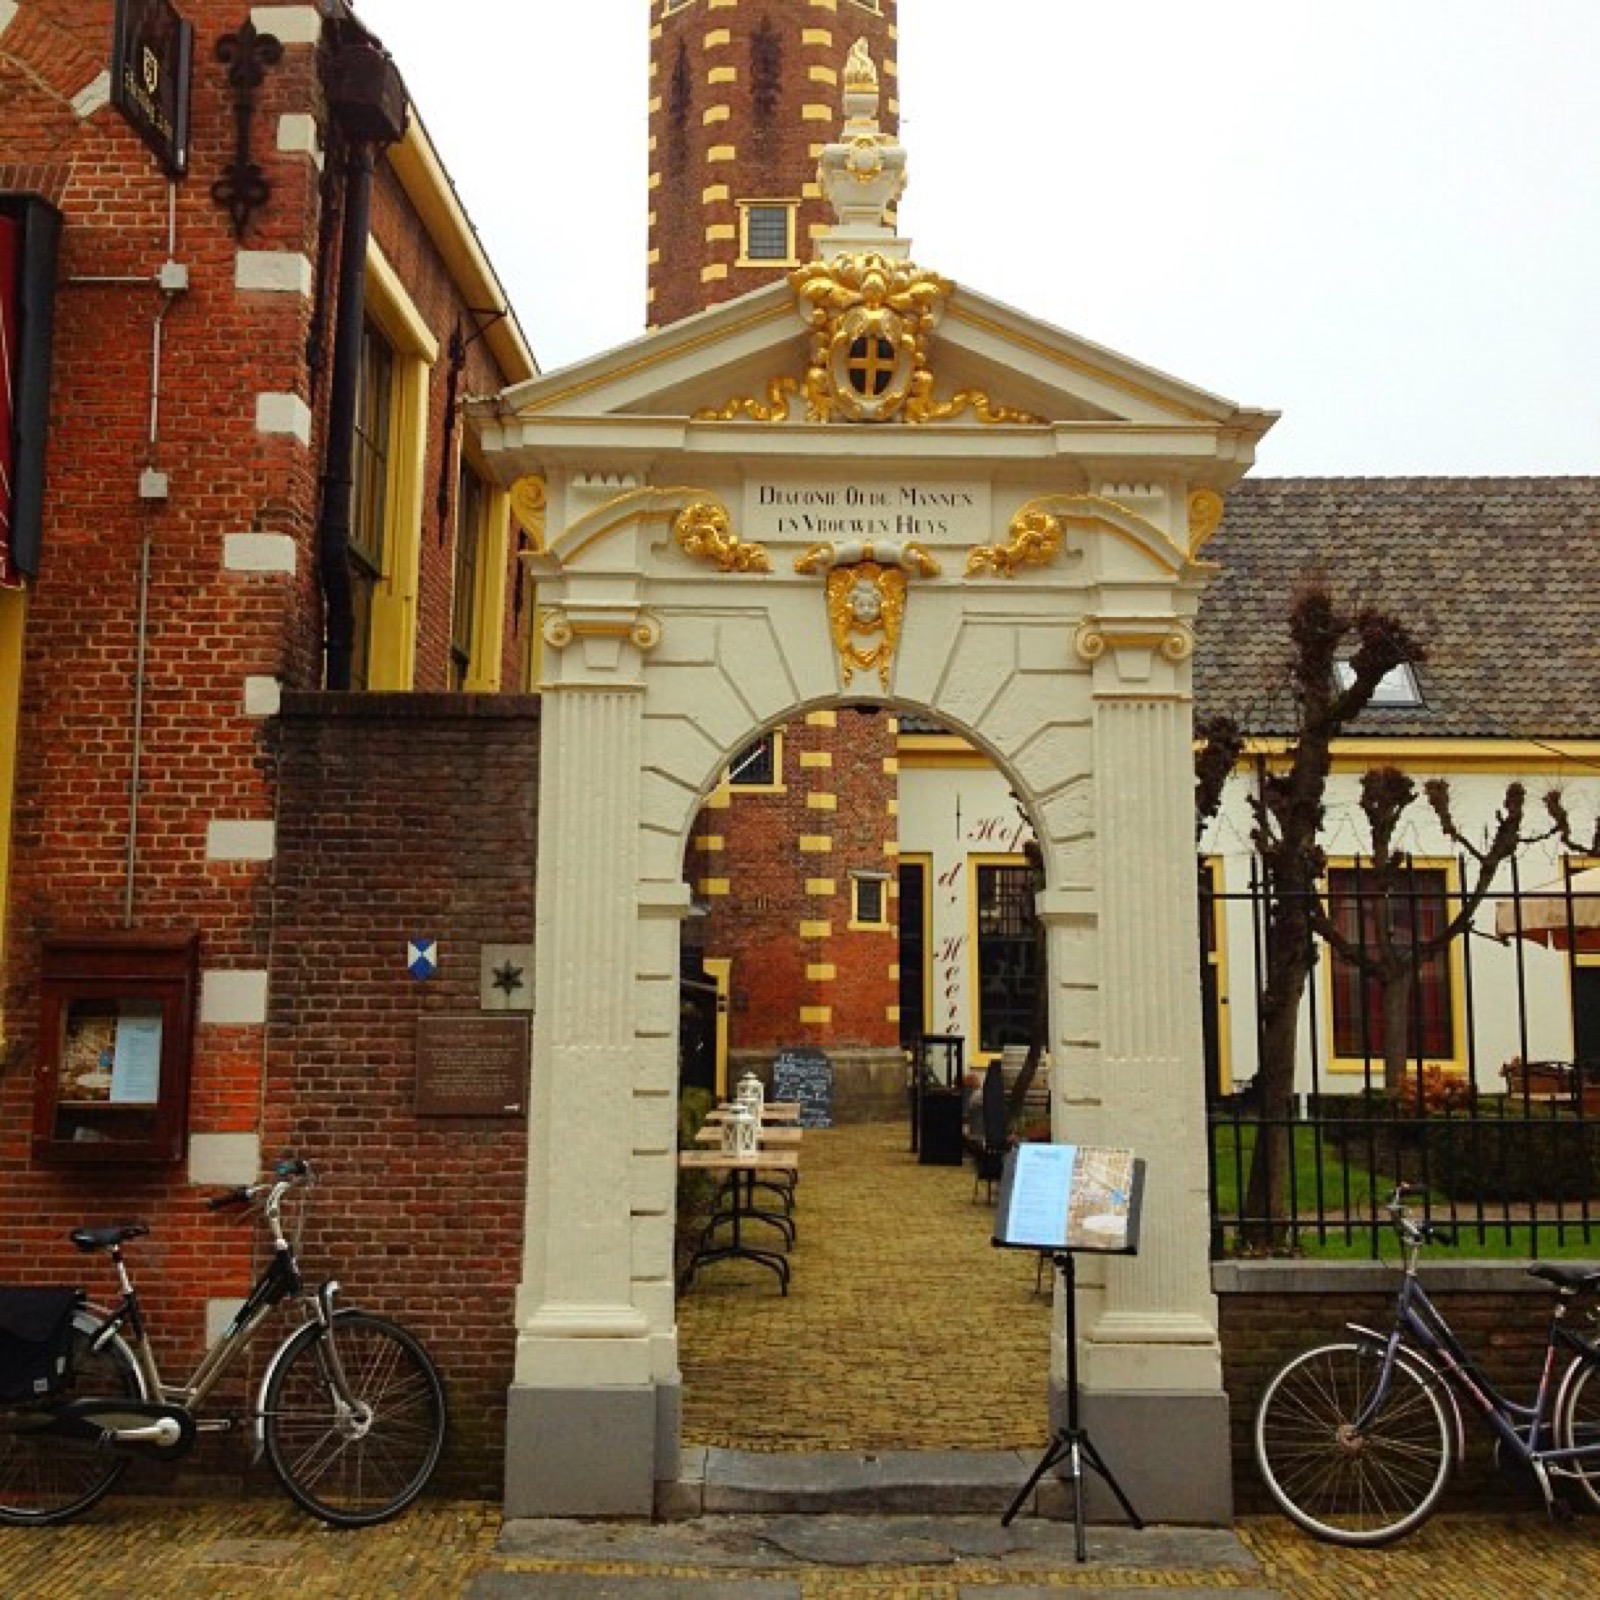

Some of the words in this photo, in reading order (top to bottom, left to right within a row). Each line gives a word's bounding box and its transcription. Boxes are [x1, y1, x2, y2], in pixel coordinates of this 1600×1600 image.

[900, 485, 973, 507] MANNEN
[778, 517, 799, 534] EN
[802, 514, 890, 535] VROUWEN
[896, 514, 948, 534] HUYS
